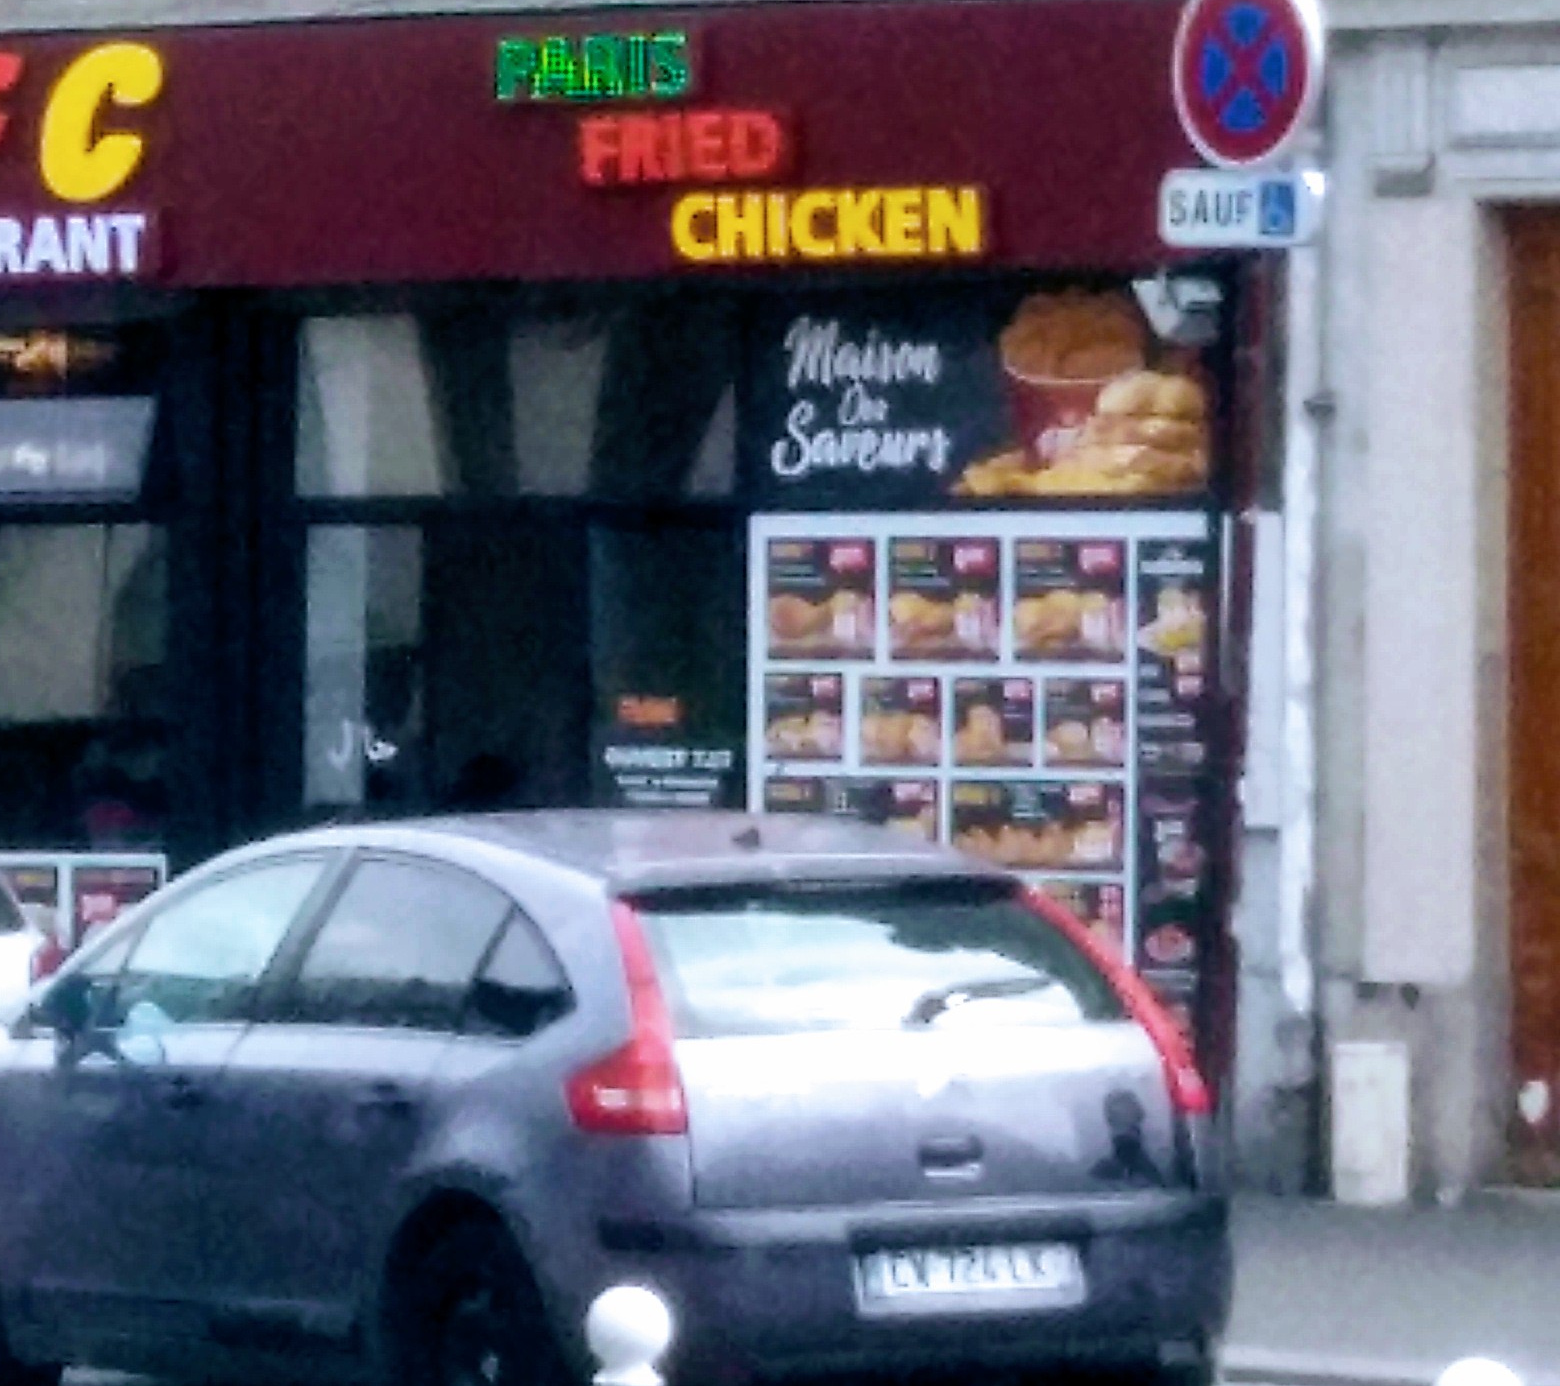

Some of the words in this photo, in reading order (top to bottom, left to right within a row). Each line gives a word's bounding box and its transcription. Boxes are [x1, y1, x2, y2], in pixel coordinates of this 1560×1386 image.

[495, 31, 692, 100] PARIS
[578, 111, 782, 186] FRIED
[671, 186, 983, 261] CHICKEN
[1169, 189, 1253, 224] SAUF
[784, 315, 939, 387] Maison
[771, 400, 951, 476] Saveurs
